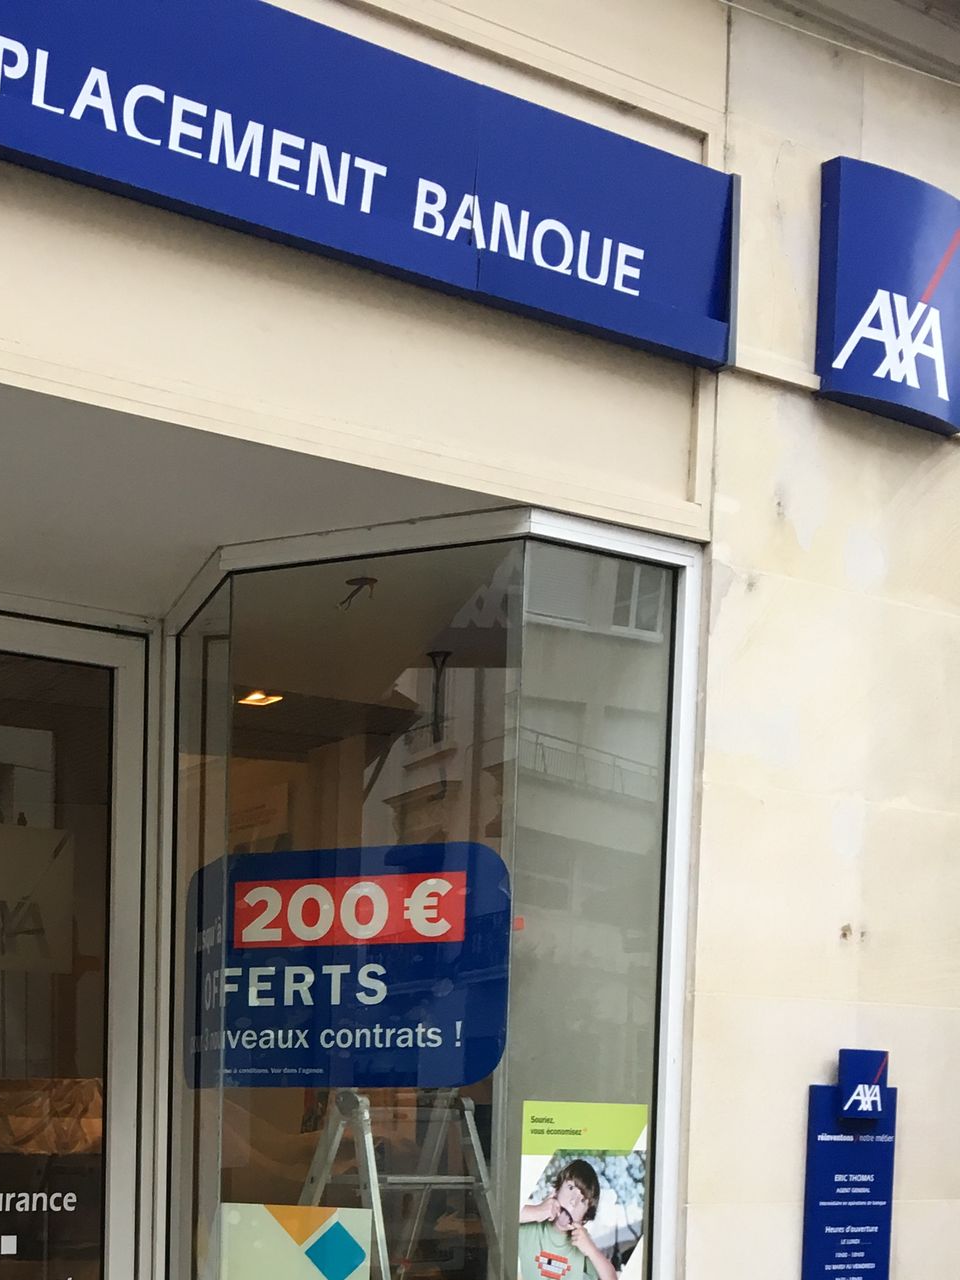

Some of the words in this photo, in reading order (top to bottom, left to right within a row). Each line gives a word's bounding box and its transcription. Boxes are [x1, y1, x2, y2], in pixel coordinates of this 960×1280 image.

[413, 177, 645, 296] BANQUE
[831, 288, 951, 401] AXA
[241, 880, 389, 942] 200
[403, 878, 453, 938] €
[319, 1022, 444, 1049] contrats
[843, 1084, 882, 1111] AXA
